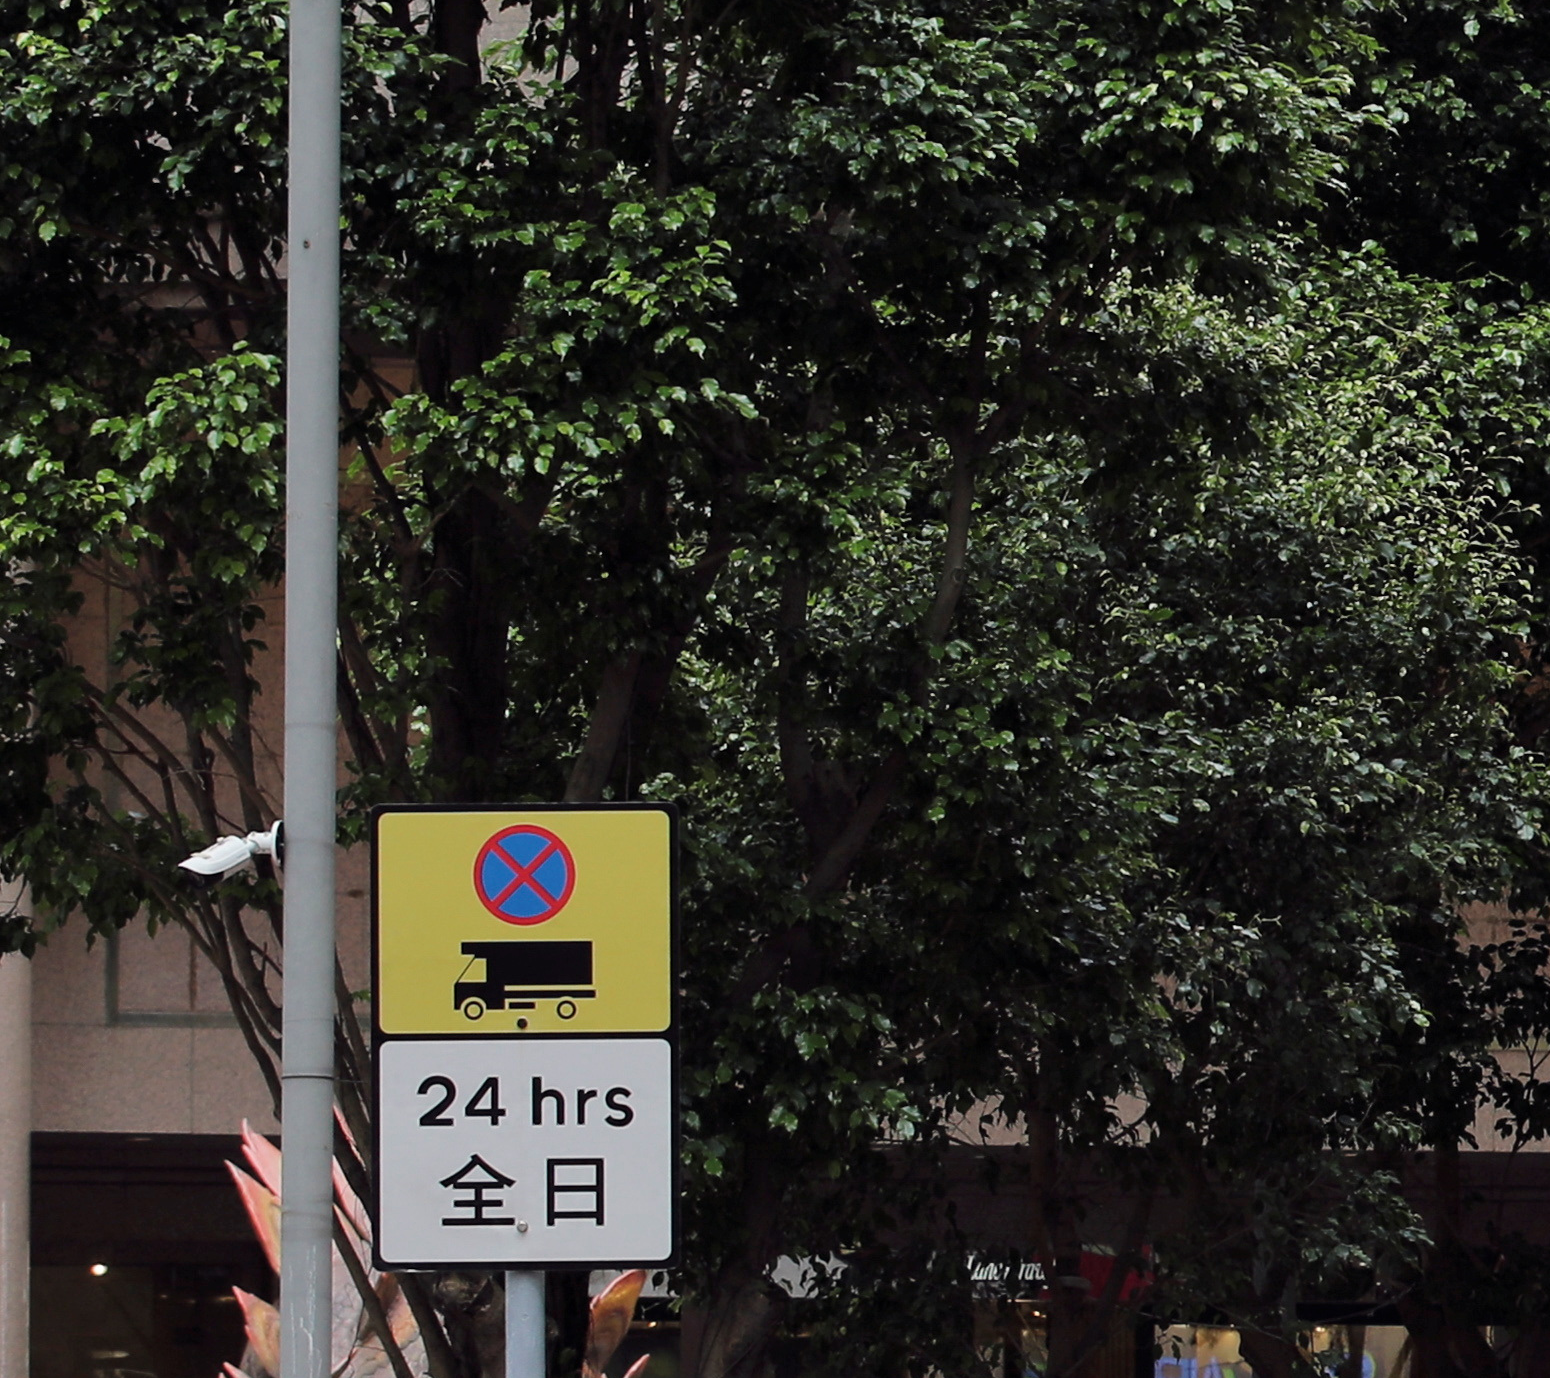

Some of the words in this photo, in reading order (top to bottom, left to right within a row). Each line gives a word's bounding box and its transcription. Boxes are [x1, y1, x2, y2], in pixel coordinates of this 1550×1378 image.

[416, 1075, 507, 1127] 24
[531, 1075, 635, 1128] hrs
[438, 1152, 606, 1227] 全日
